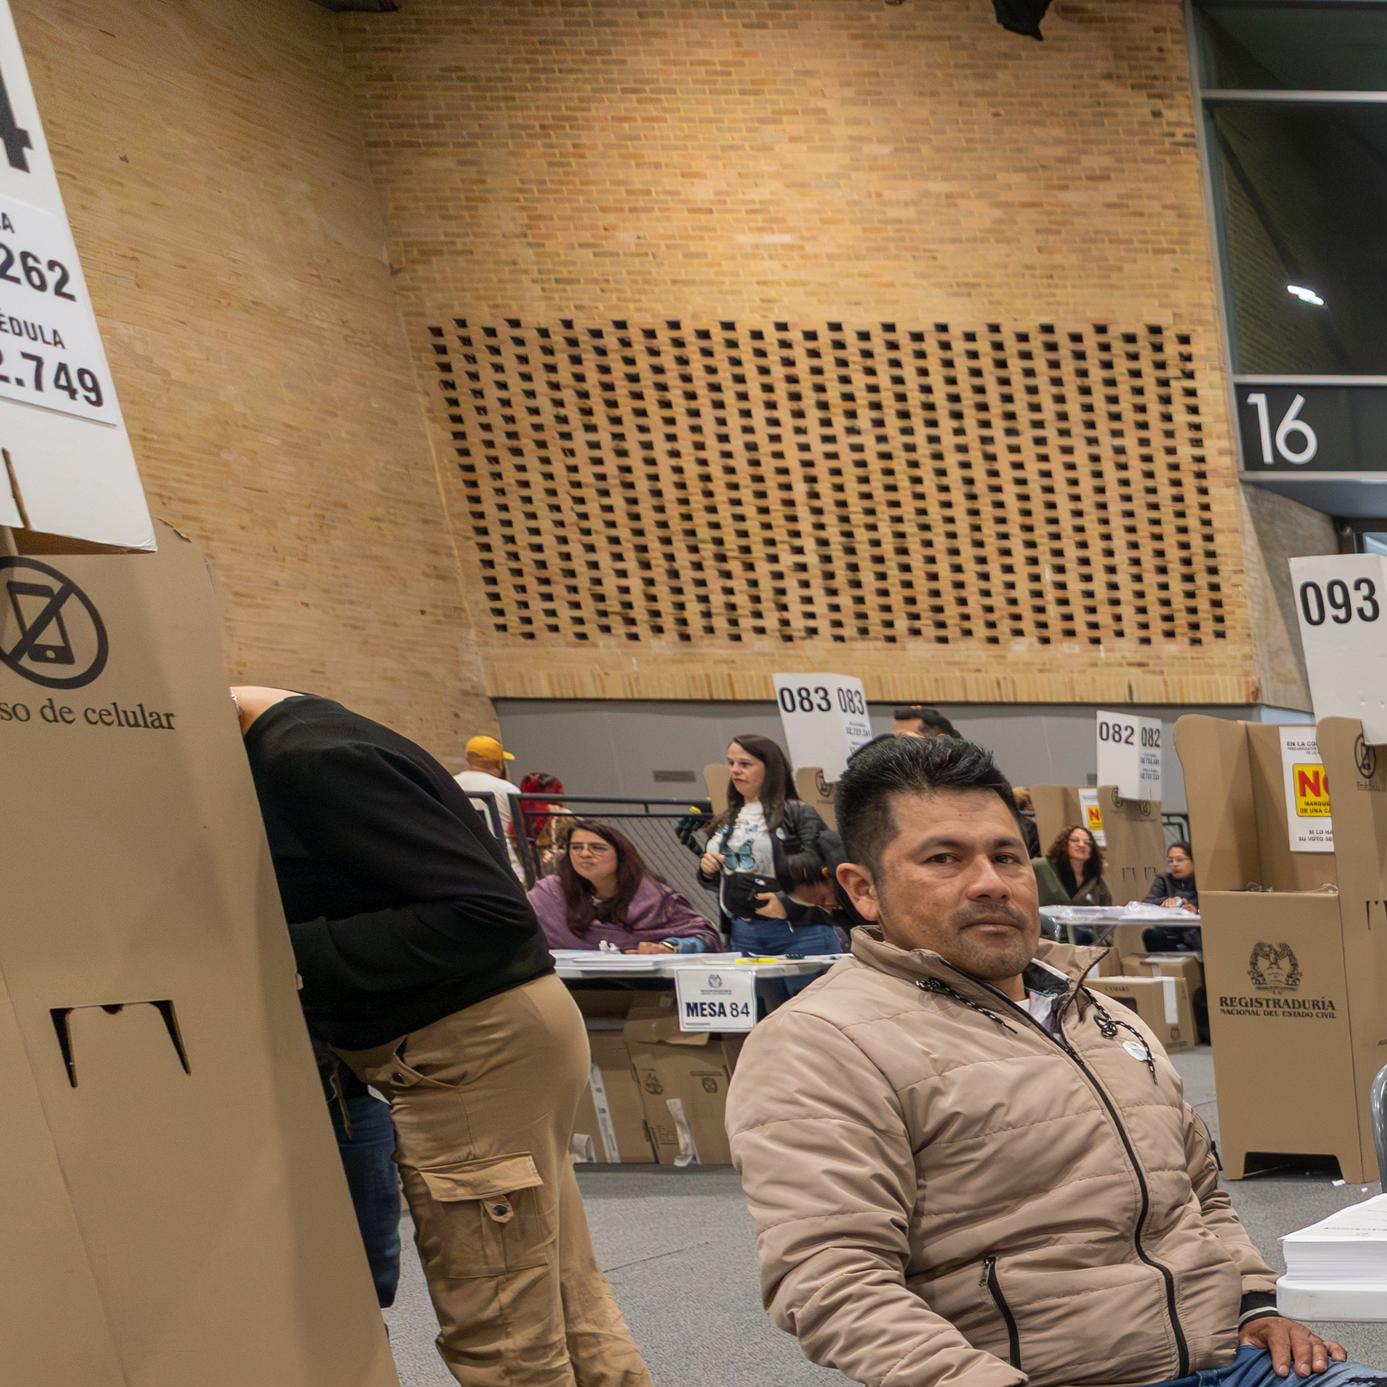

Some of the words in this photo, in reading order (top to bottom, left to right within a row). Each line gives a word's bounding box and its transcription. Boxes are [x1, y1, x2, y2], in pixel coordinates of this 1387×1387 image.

[1246, 393, 1318, 465] 16
[1300, 577, 1380, 626] 093
[779, 687, 832, 713] 083
[837, 687, 865, 715] 083
[41, 698, 76, 725] de
[84, 702, 175, 731] celular
[1099, 722, 1135, 746] 082
[1141, 726, 1160, 748] 082
[686, 1002, 727, 1018] MESA
[730, 1002, 750, 1018] 84
[1219, 995, 1336, 1012] REGISTRADURÍA
[1220, 1008, 1260, 1017] NACIONAL
[1282, 1010, 1313, 1018] ESTADO
